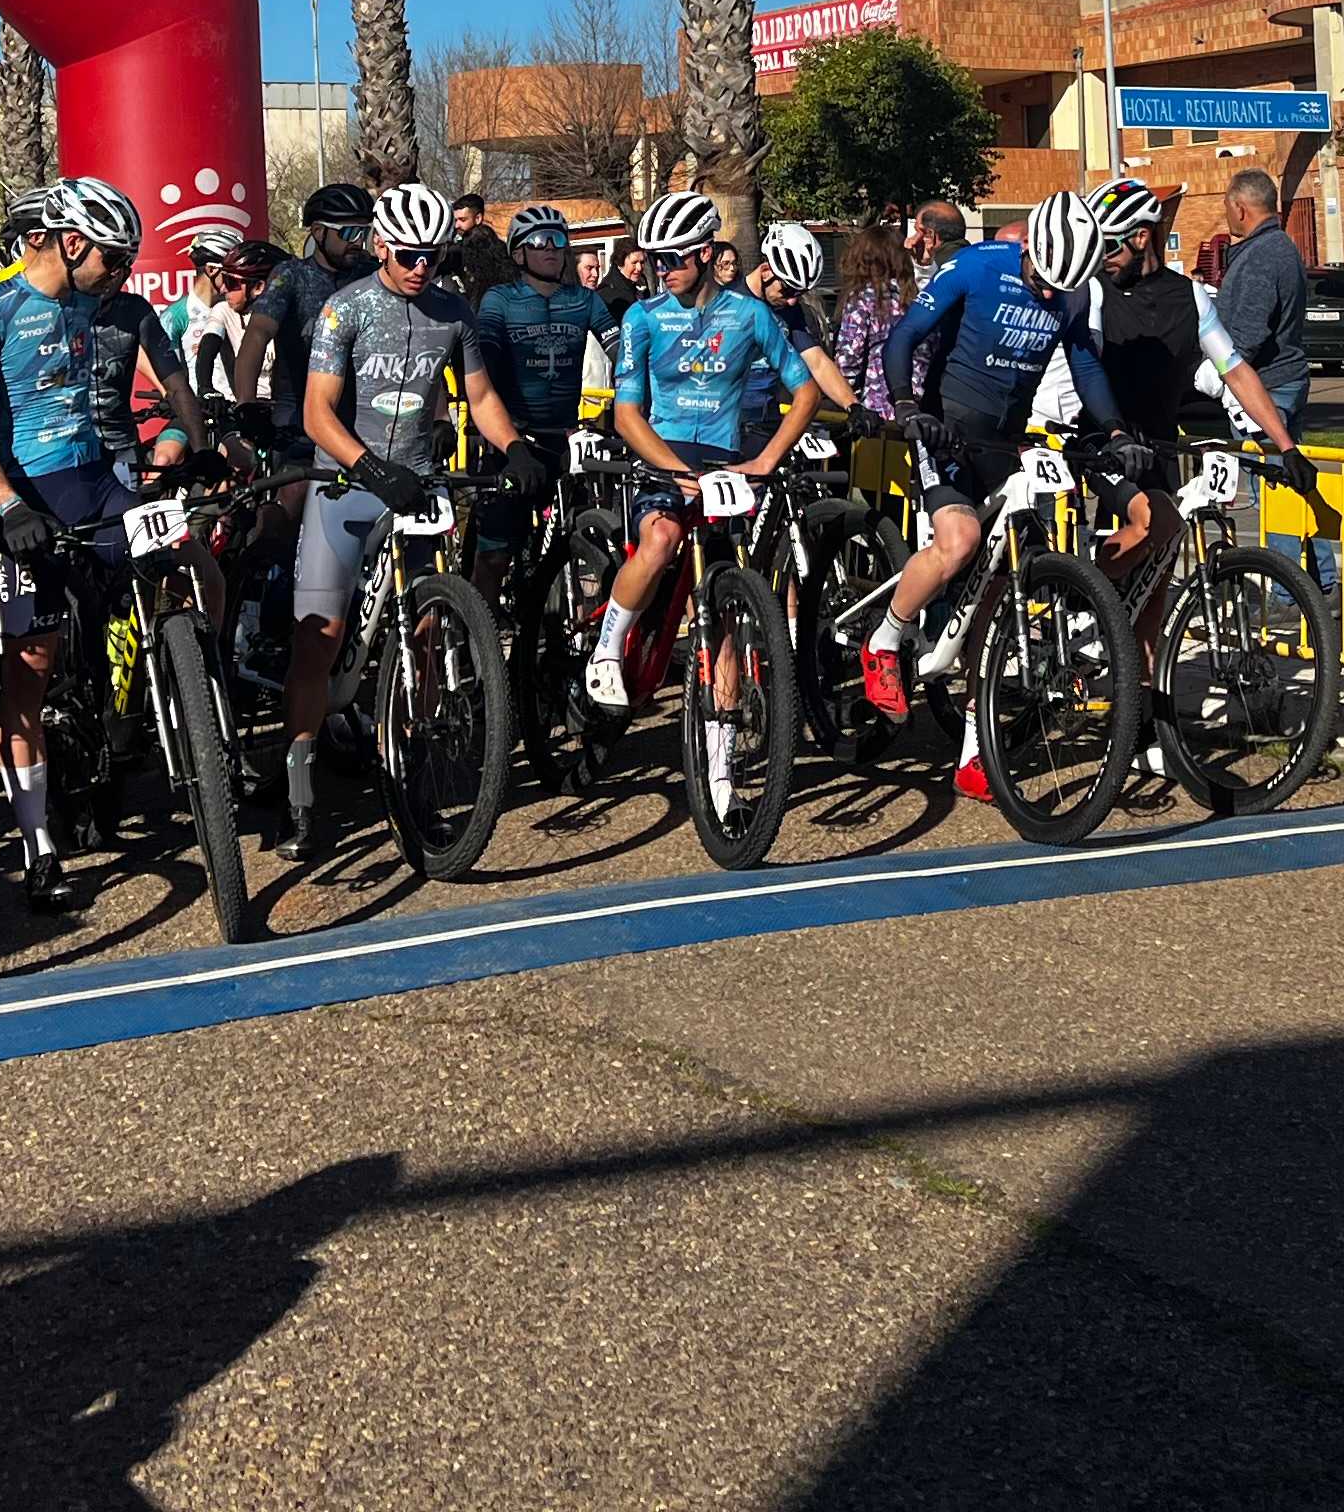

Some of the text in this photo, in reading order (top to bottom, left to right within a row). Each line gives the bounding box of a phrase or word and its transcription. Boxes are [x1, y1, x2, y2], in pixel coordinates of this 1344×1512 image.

[752, 2, 858, 46] OLIDEPORTIVO
[753, 50, 782, 73] STAL
[1125, 97, 1175, 123] HOSTAL
[1185, 99, 1273, 124] RESTAURANTE
[122, 269, 197, 302] DIPUT
[993, 303, 1063, 331] FERNANDO
[999, 327, 1052, 352] TORRES
[804, 436, 826, 453] 41
[1035, 460, 1062, 485] 43
[1208, 462, 1230, 495] 32
[712, 481, 737, 506] 11
[140, 511, 169, 540] 10
[114, 604, 139, 715] SCOT
